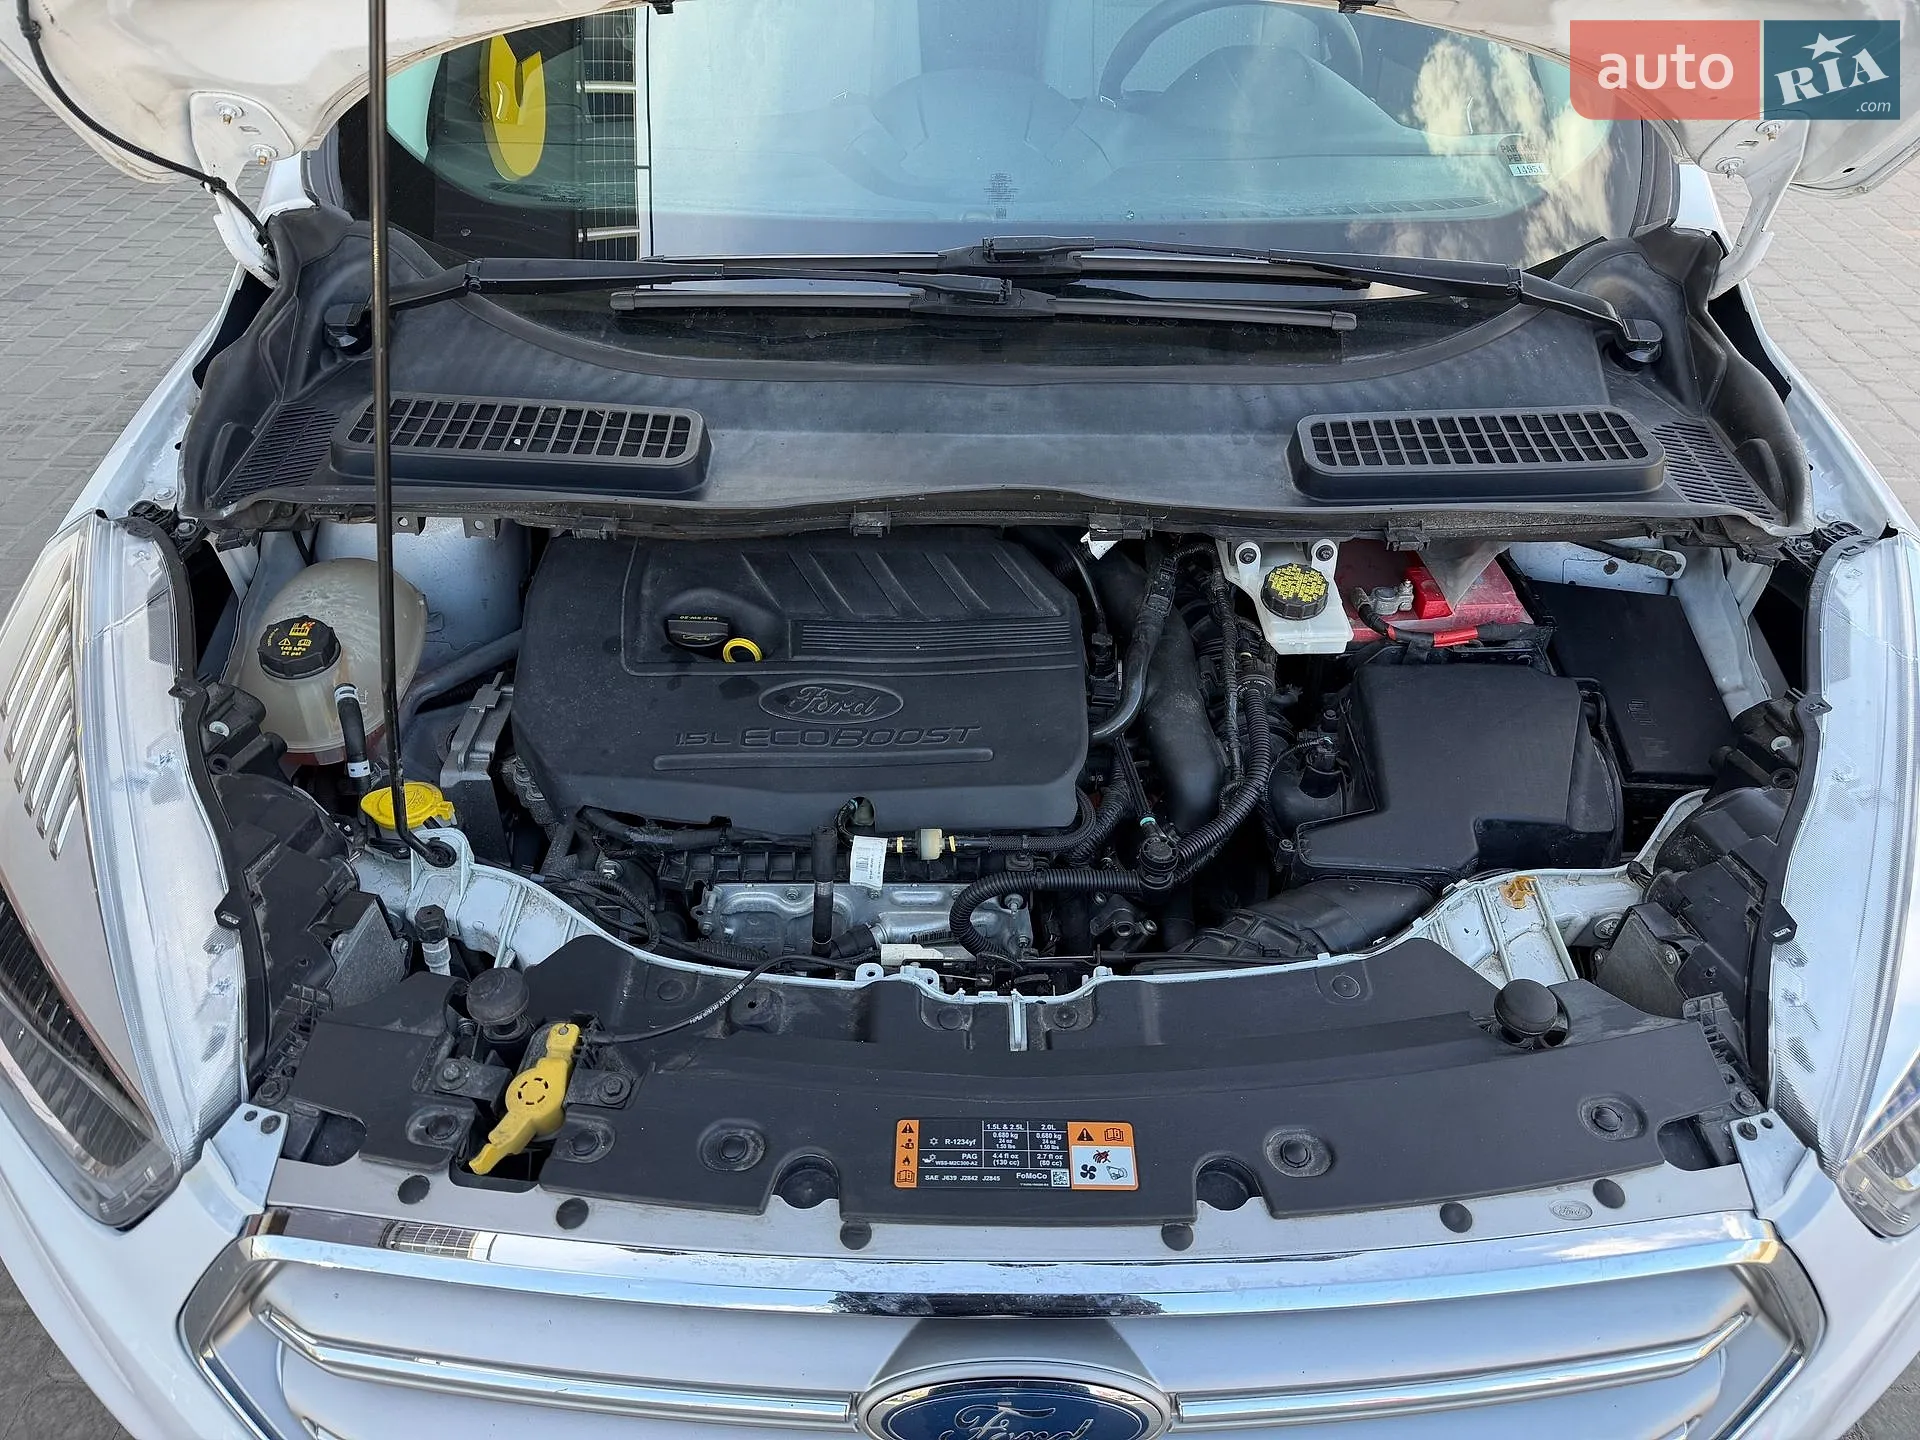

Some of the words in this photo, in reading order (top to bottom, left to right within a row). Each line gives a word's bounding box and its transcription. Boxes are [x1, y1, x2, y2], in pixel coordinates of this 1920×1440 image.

[785, 686, 880, 717] Ford
[739, 726, 981, 749] ECOBOOST
[1010, 1131, 1019, 1140] kg
[1053, 1132, 1062, 1141] kg
[944, 1138, 977, 1147] R-1234yf
[992, 1159, 1008, 1167] (130
[1008, 1159, 1020, 1167] cc)
[1051, 1160, 1063, 1168] cc)
[1016, 1172, 1048, 1180] FoMoCo
